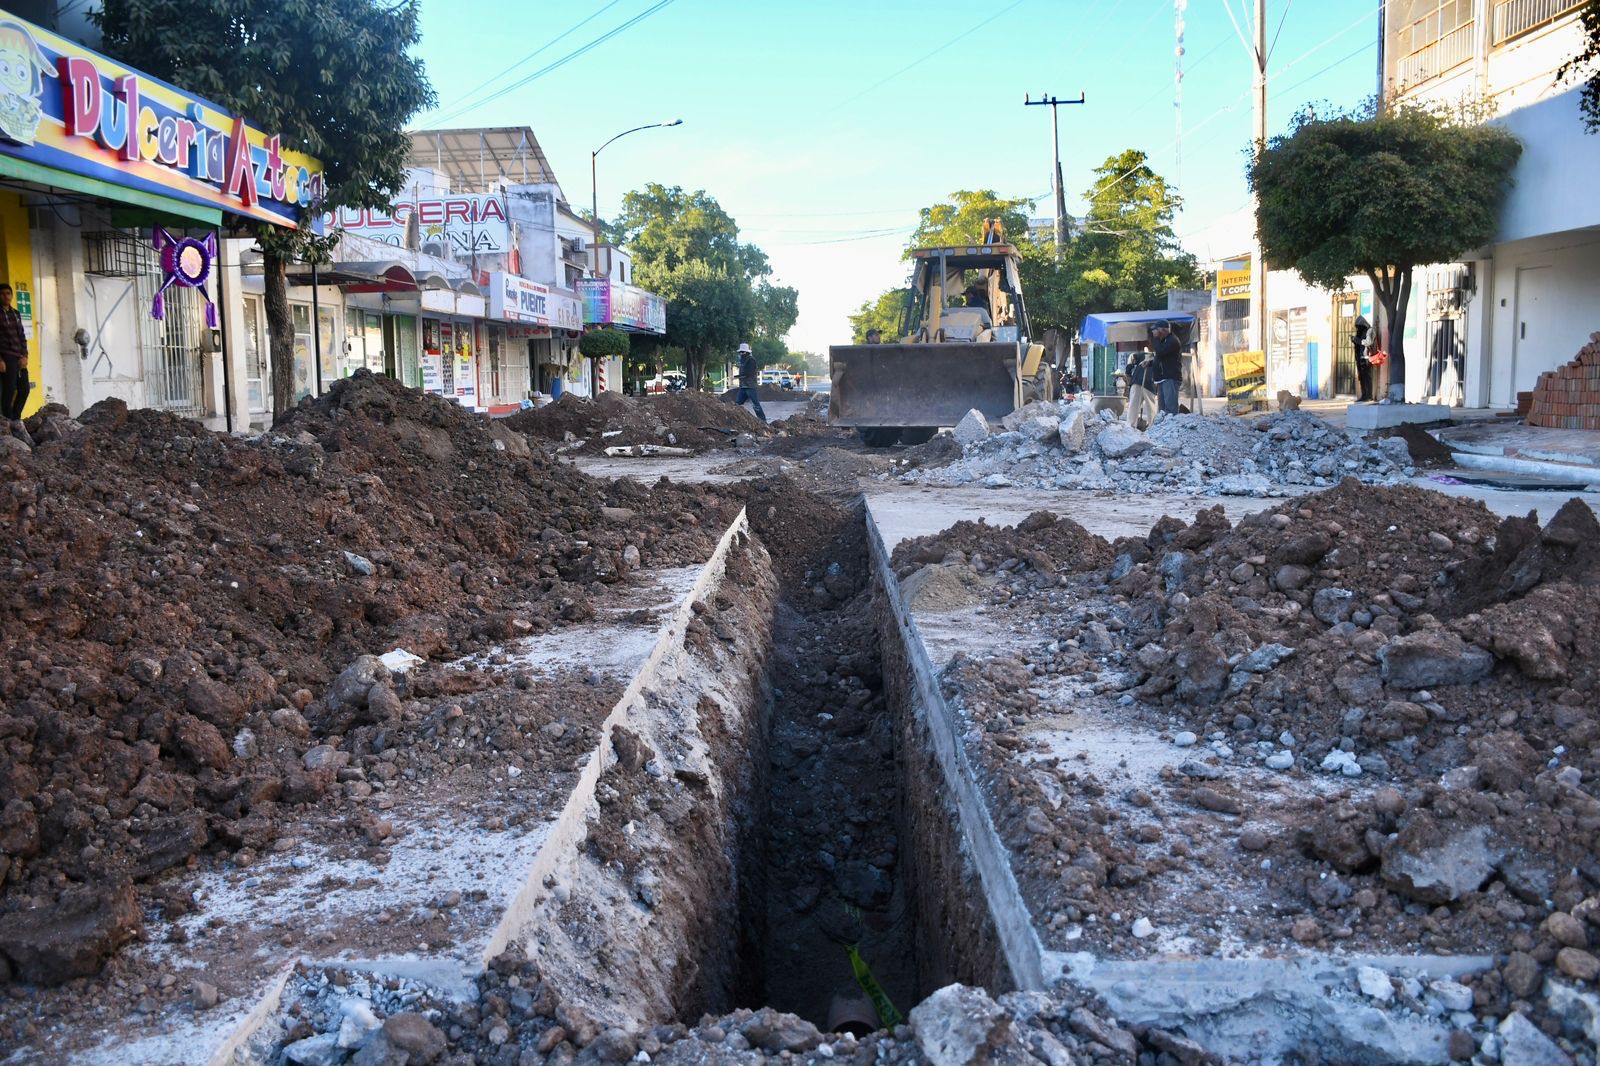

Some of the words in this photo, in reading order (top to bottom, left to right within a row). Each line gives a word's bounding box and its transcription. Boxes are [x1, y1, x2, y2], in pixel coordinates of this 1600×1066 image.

[61, 56, 225, 183] Dulceria
[223, 116, 323, 207] Azteca
[1221, 275, 1251, 285] INTERN
[1226, 352, 1262, 367] Cyber
